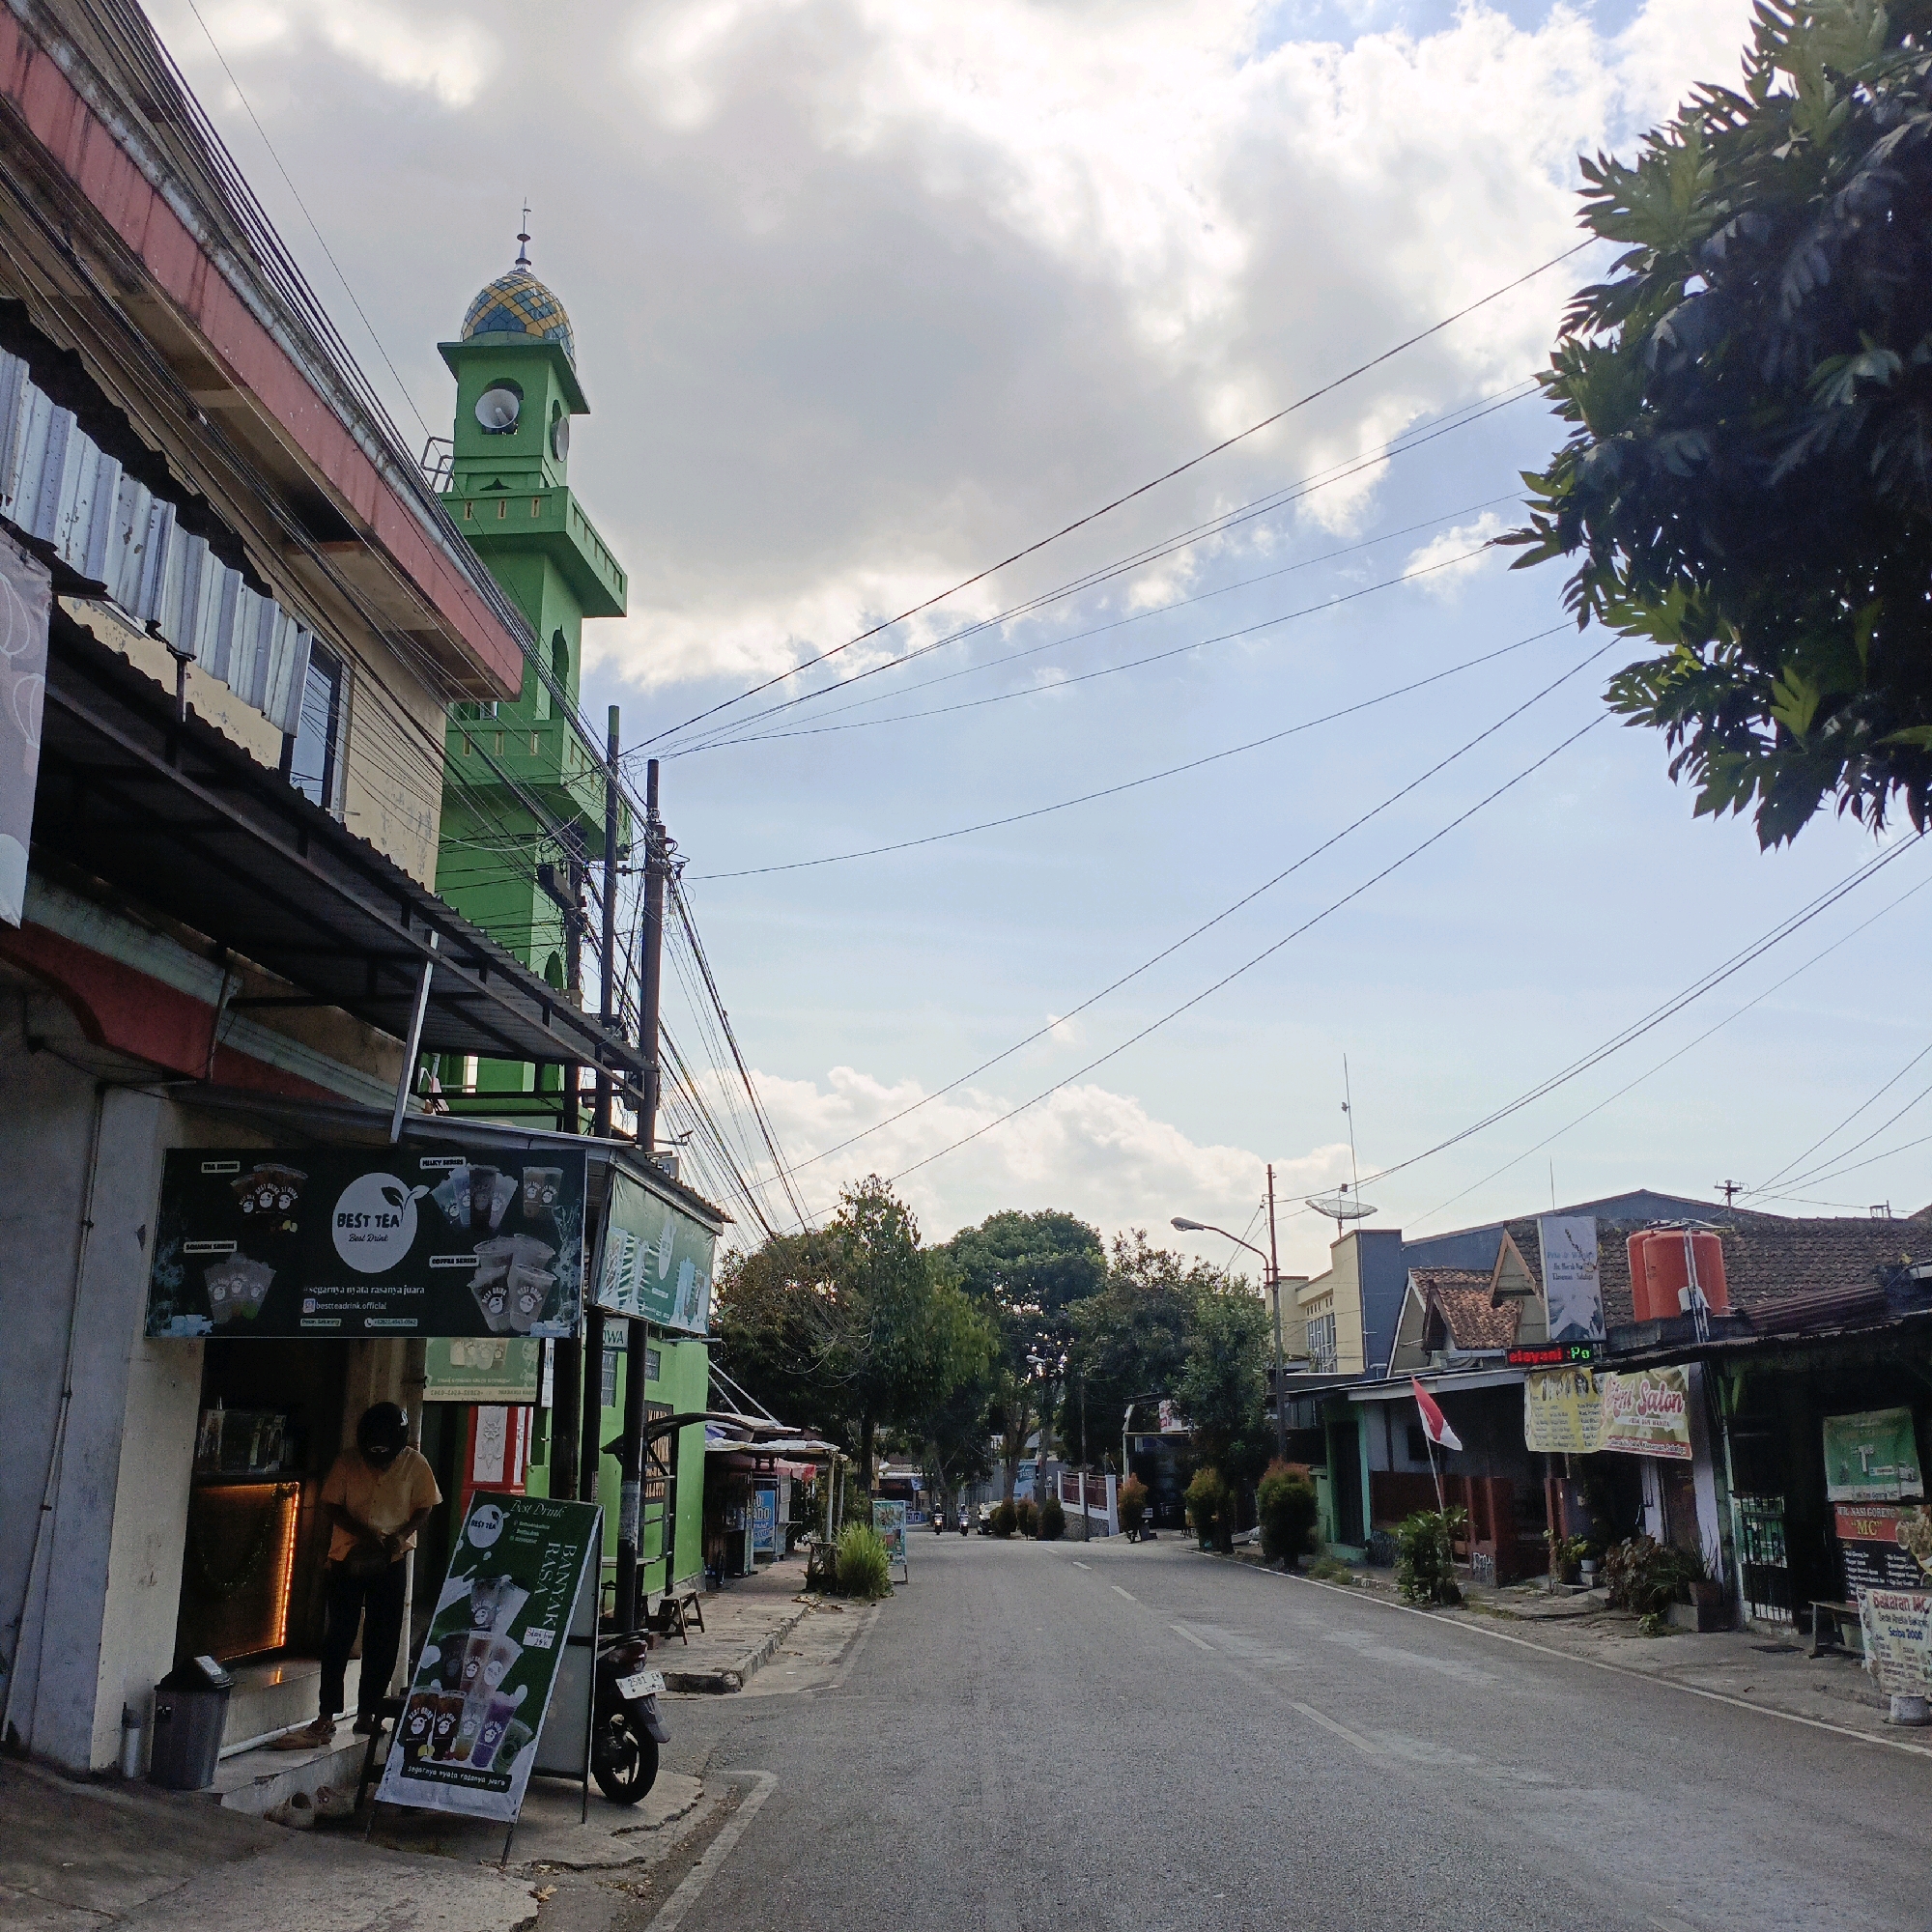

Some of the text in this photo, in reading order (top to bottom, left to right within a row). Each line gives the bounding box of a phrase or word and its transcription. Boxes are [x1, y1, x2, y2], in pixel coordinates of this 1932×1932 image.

[337, 1212, 400, 1229] BEST TEA
[348, 1233, 389, 1242] Best Drink
[346, 1286, 369, 1295] nyata
[370, 1286, 403, 1295] rasanya
[403, 1284, 425, 1295] juara
[1637, 1379, 1685, 1417] Salon
[533, 1502, 568, 1519] Drink
[1851, 1507, 1866, 1517] NASI
[1867, 1507, 1896, 1518] GORENG
[534, 1542, 560, 1596] RASA
[542, 1544, 578, 1627] BANYAK
[408, 1765, 506, 1788] segarnya nyata rasanya juara
